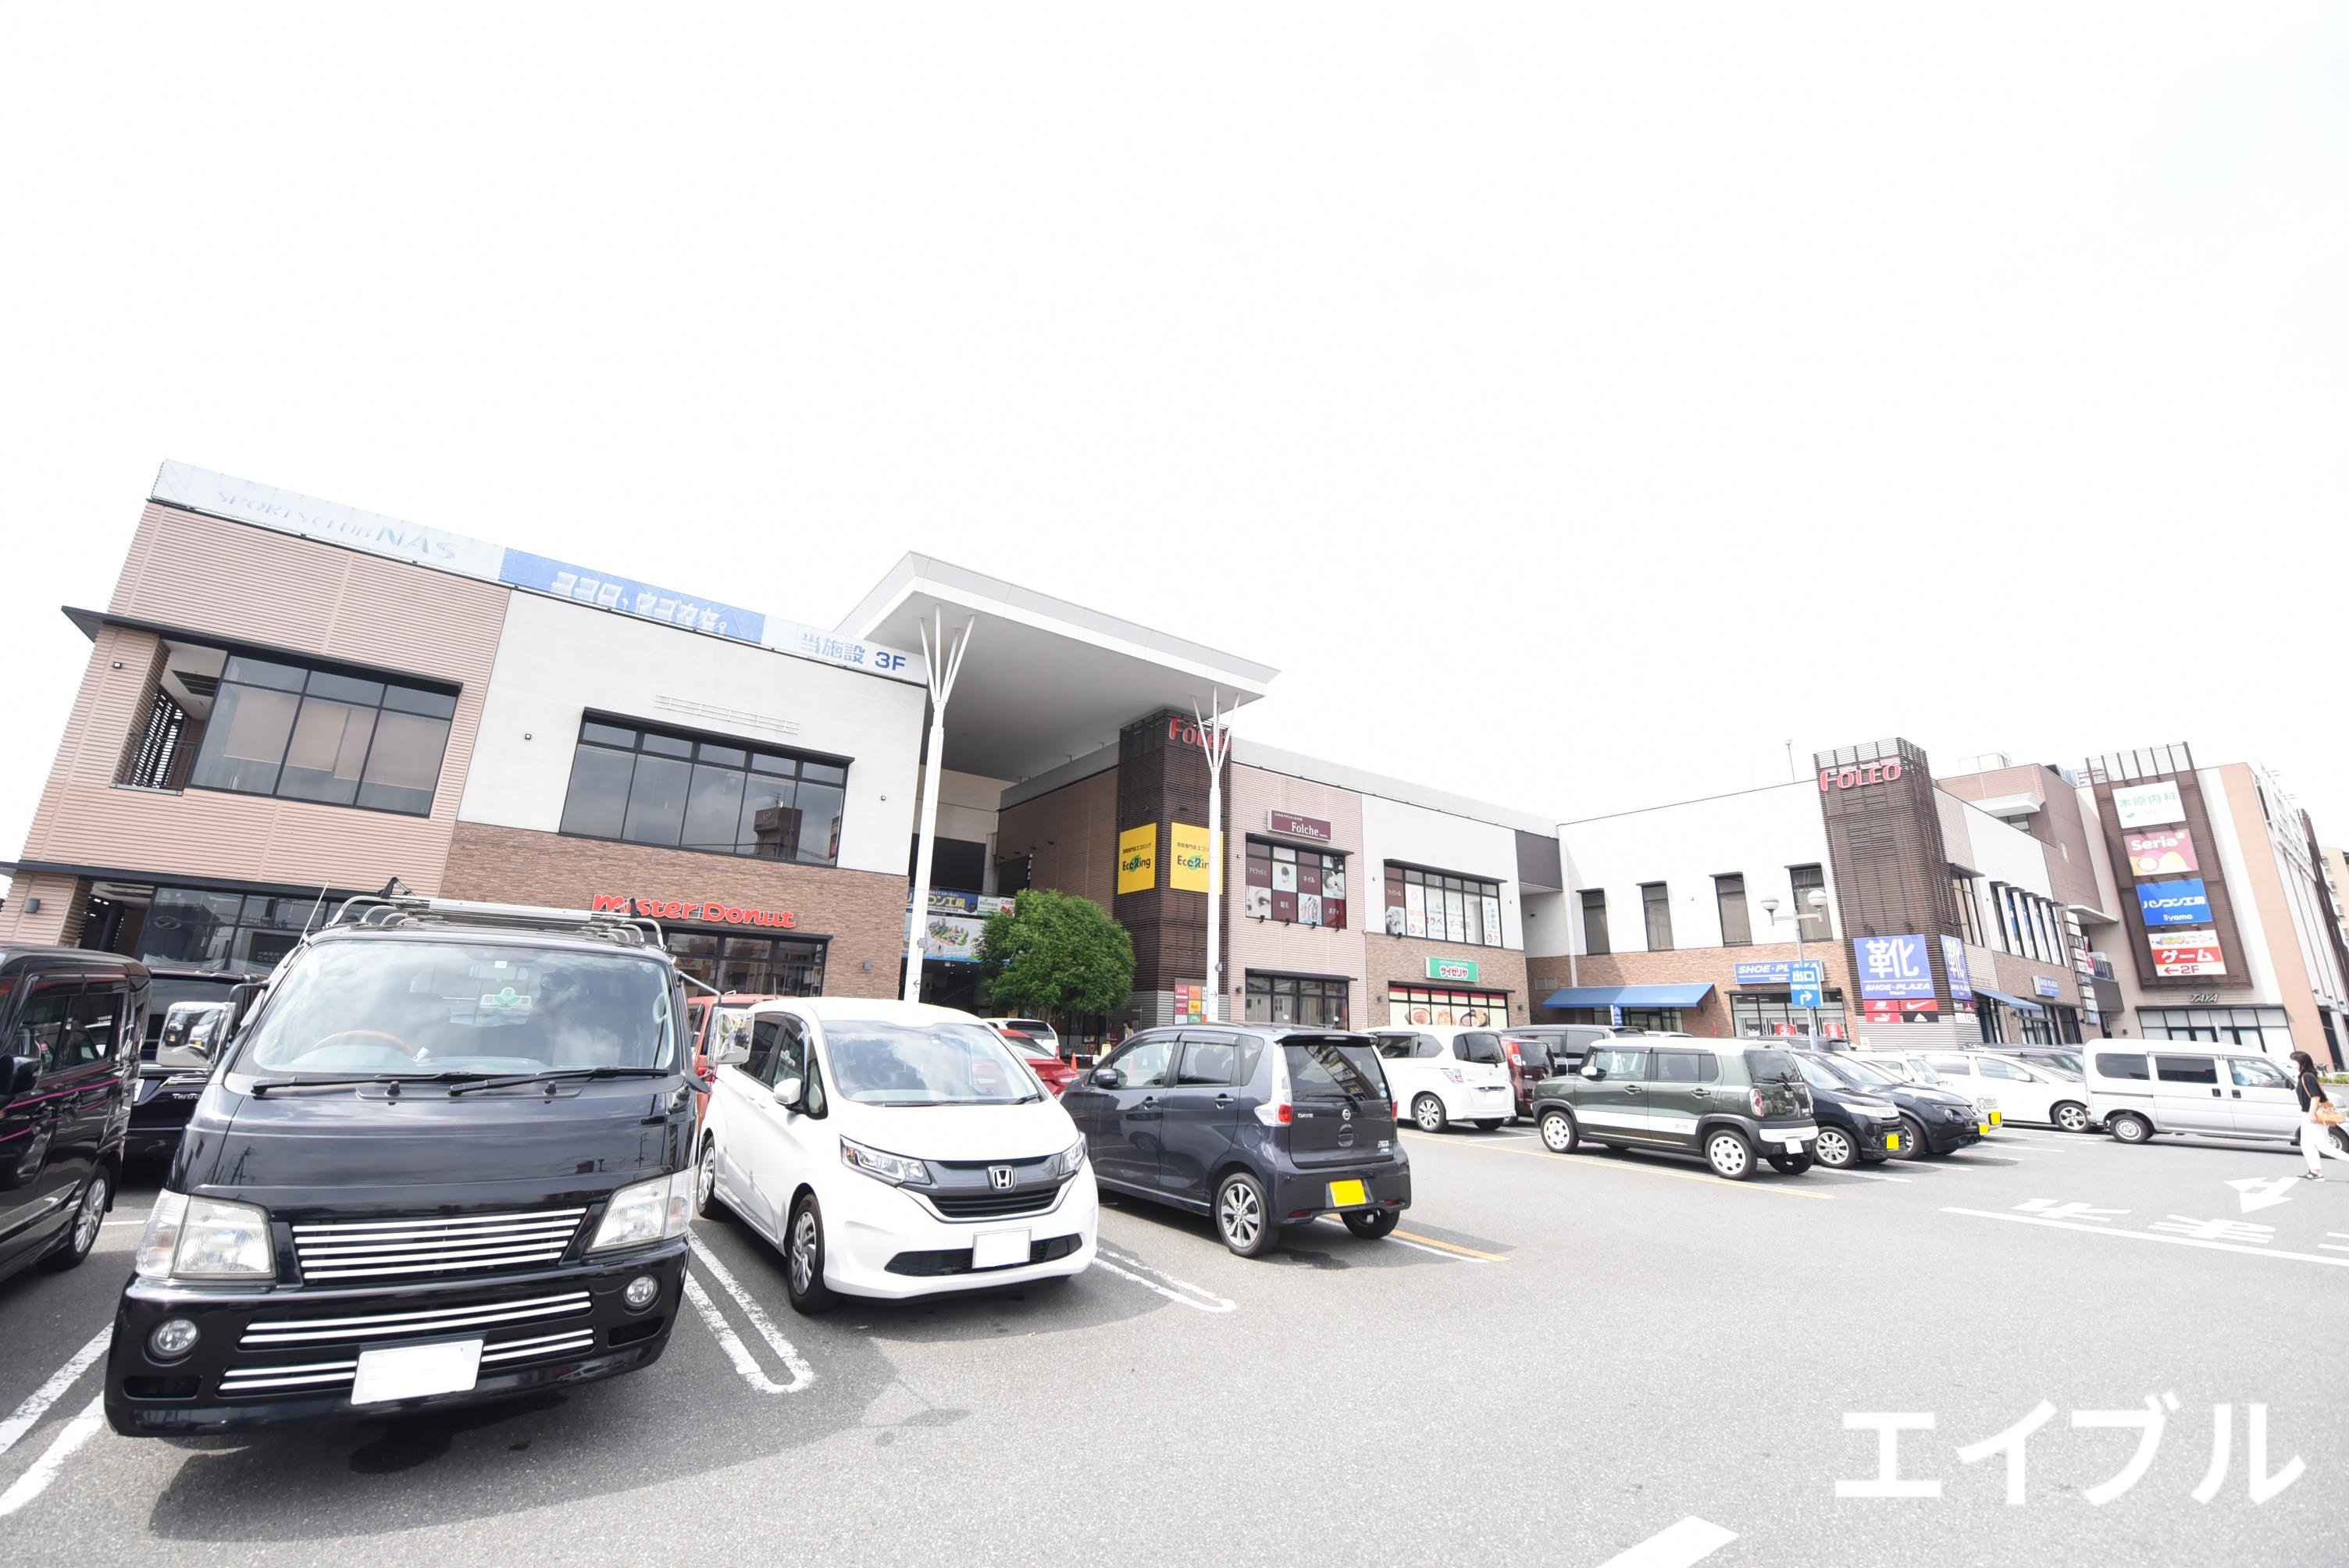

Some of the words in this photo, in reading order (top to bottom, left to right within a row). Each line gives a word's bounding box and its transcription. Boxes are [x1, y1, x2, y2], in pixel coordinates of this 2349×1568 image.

[375, 526, 457, 559] NAS
[875, 651, 906, 671] 3F
[1291, 821, 1319, 836] Folche
[2130, 836, 2178, 851] Seria
[979, 899, 998, 907] mineo
[701, 901, 797, 928] Donut
[1865, 938, 1919, 978] 靴
[1944, 939, 1965, 978] 靴
[2161, 949, 2215, 963] ゲーム
[1440, 966, 1468, 978] サイゼリヤ
[1792, 970, 1816, 982] 出口
[2180, 965, 2200, 975] 2F
[2190, 992, 2219, 1003] TAYA
